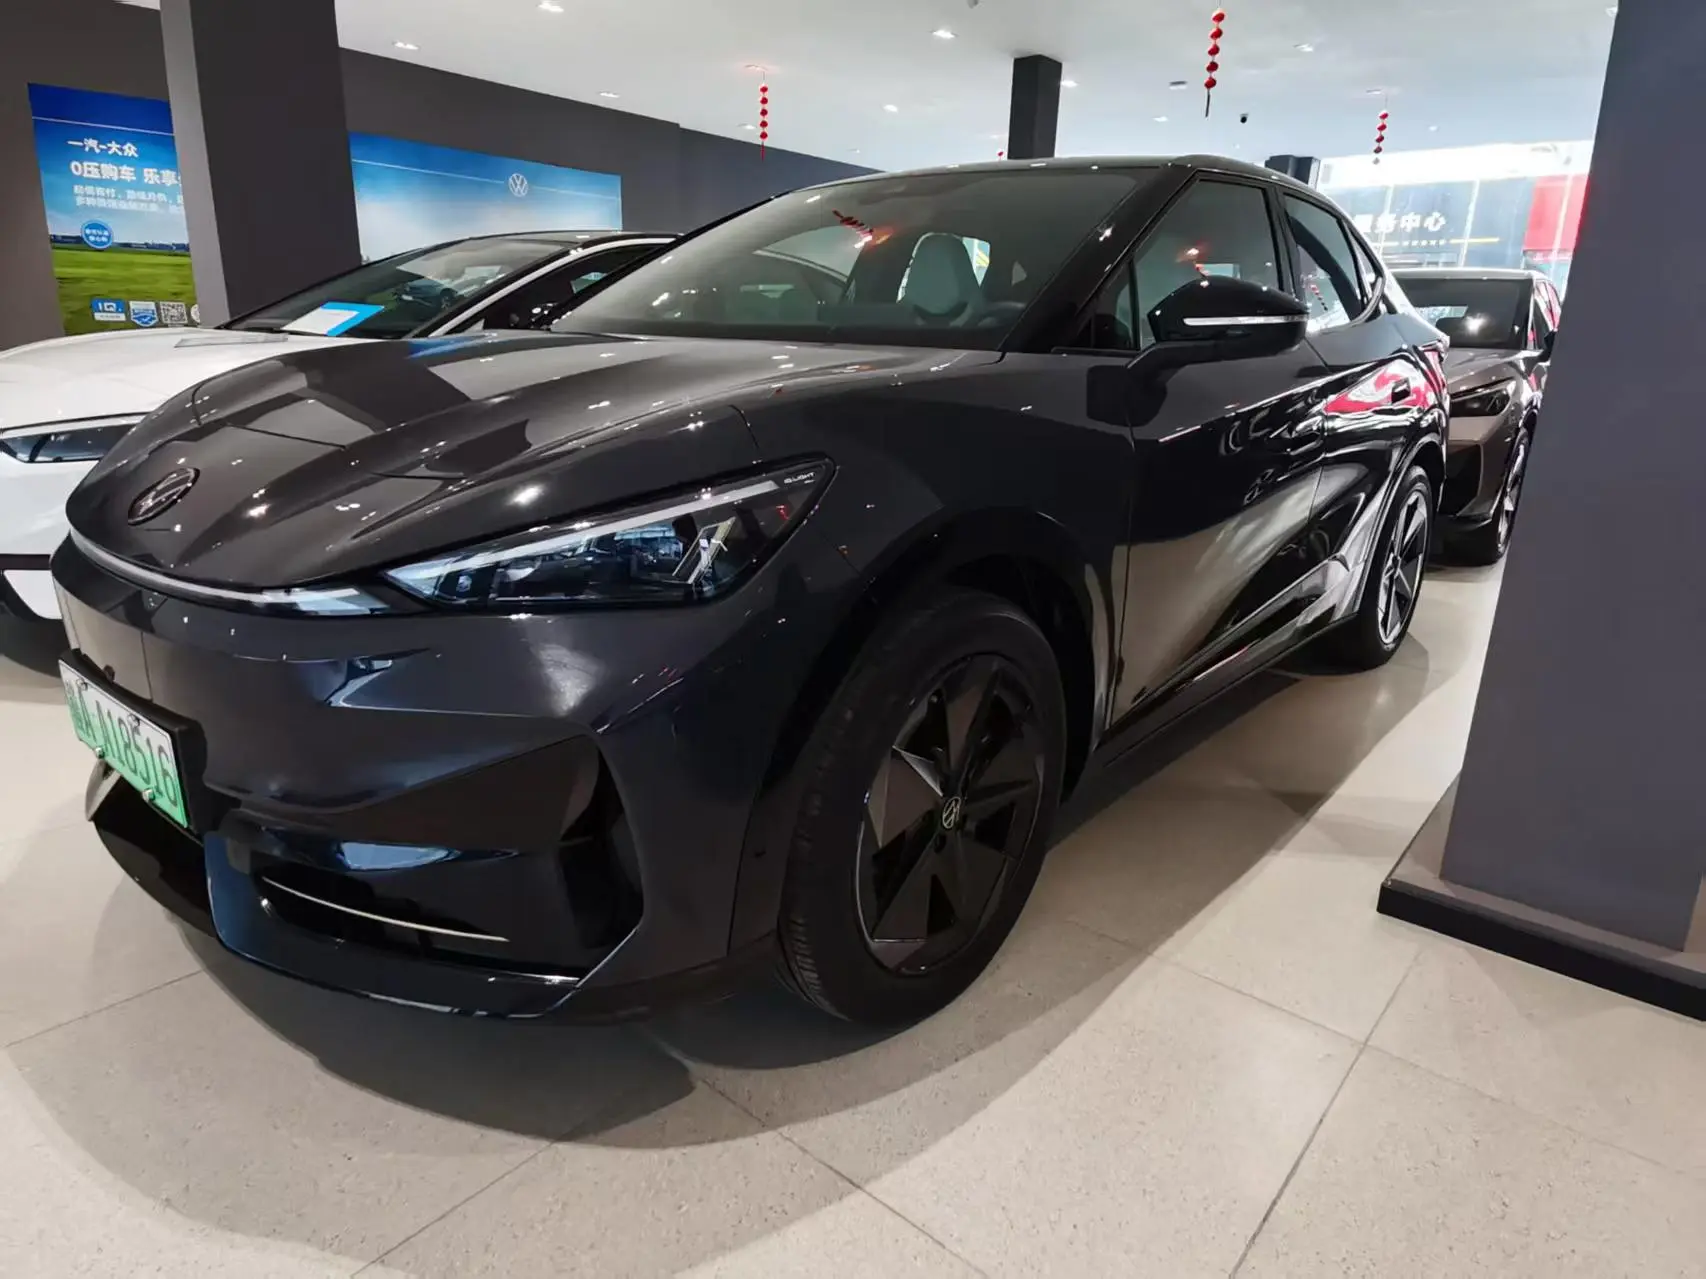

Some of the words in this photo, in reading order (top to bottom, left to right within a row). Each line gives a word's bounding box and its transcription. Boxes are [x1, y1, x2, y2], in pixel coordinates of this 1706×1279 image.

[67, 138, 138, 157] 一汽-大众
[71, 162, 136, 182] 0压购车
[143, 168, 182, 187] 乐享
